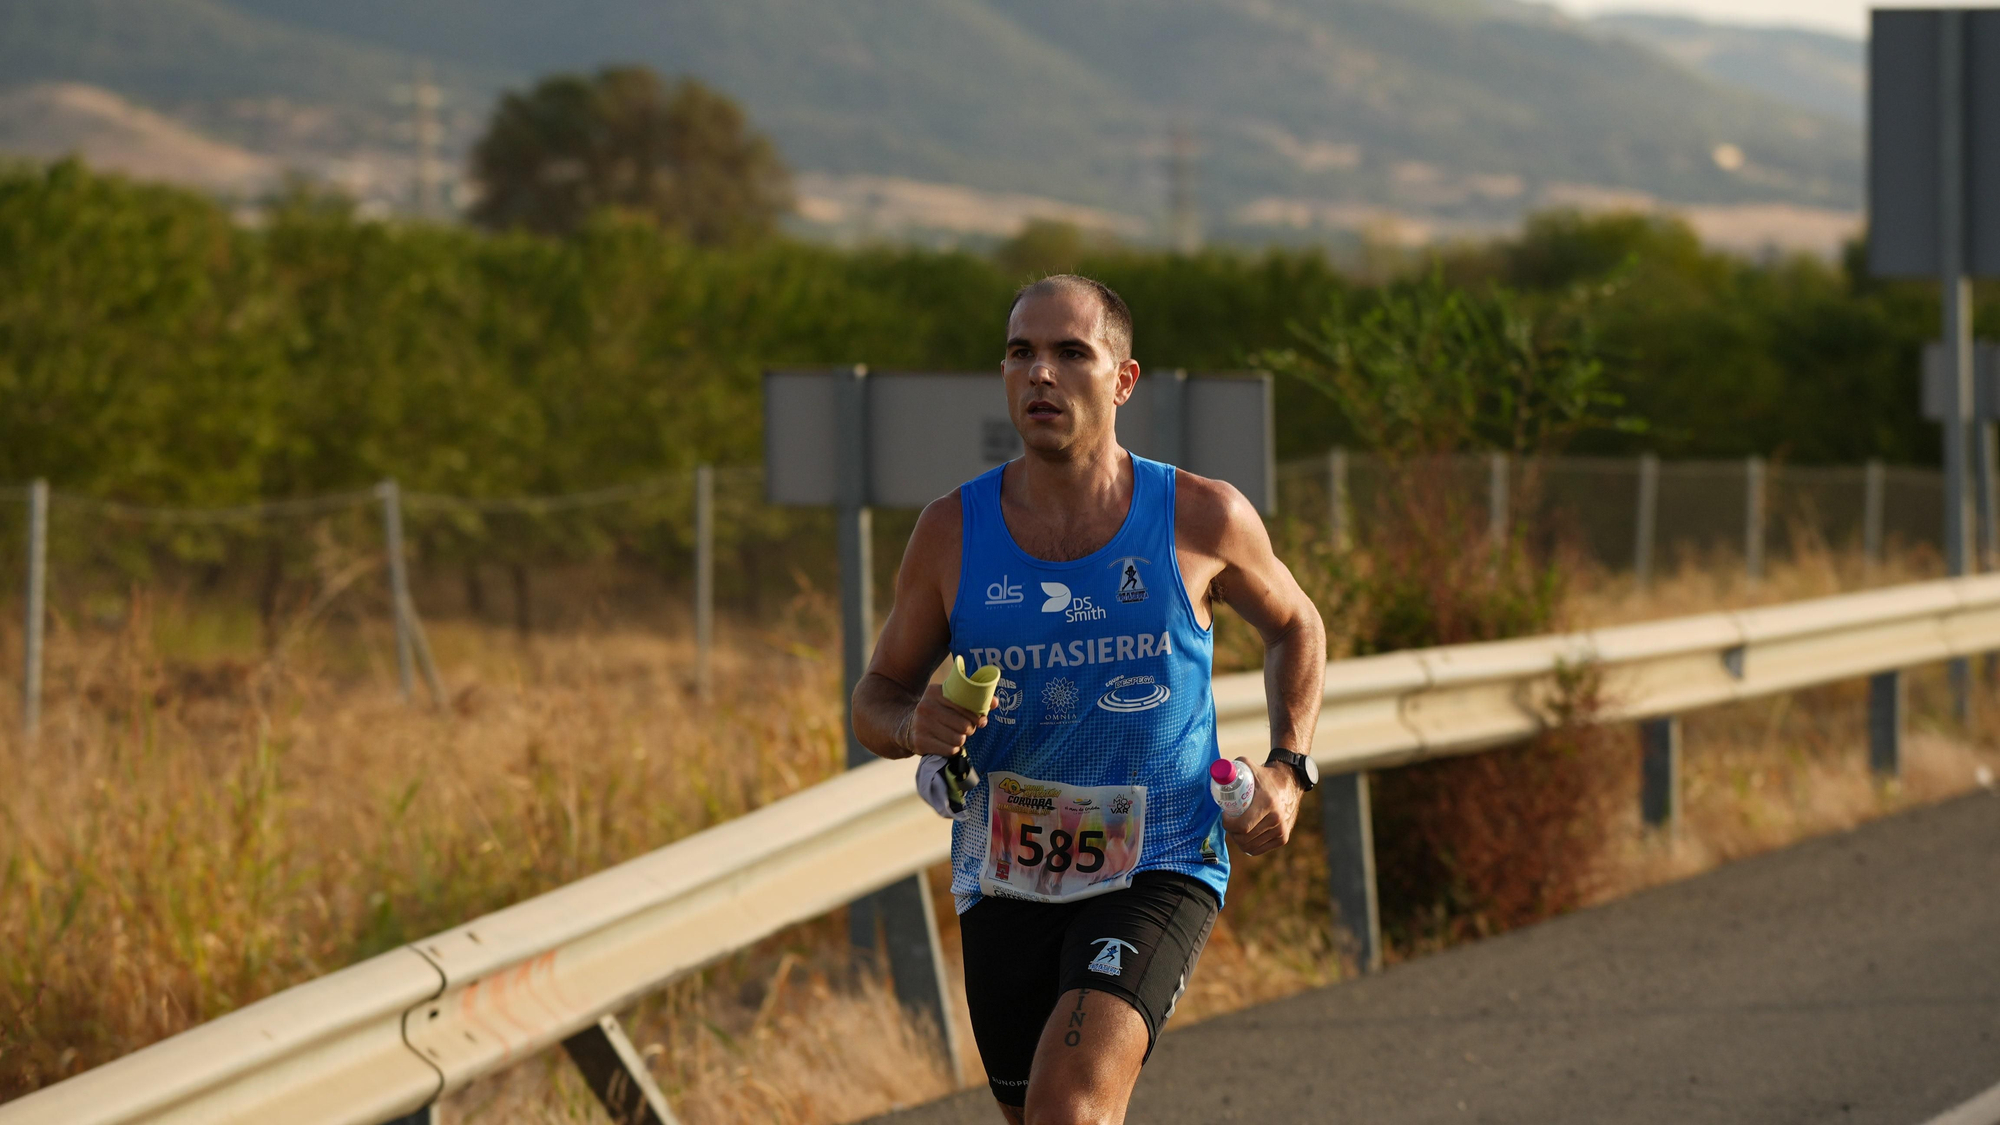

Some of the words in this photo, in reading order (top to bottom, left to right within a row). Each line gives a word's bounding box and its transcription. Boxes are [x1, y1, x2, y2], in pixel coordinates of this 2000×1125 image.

[1073, 597, 1092, 611] DS
[1065, 606, 1106, 623] Smith
[970, 631, 1172, 671] TROTASIERRA
[1045, 713, 1077, 721] OMNIA
[1017, 823, 1104, 873] 585
